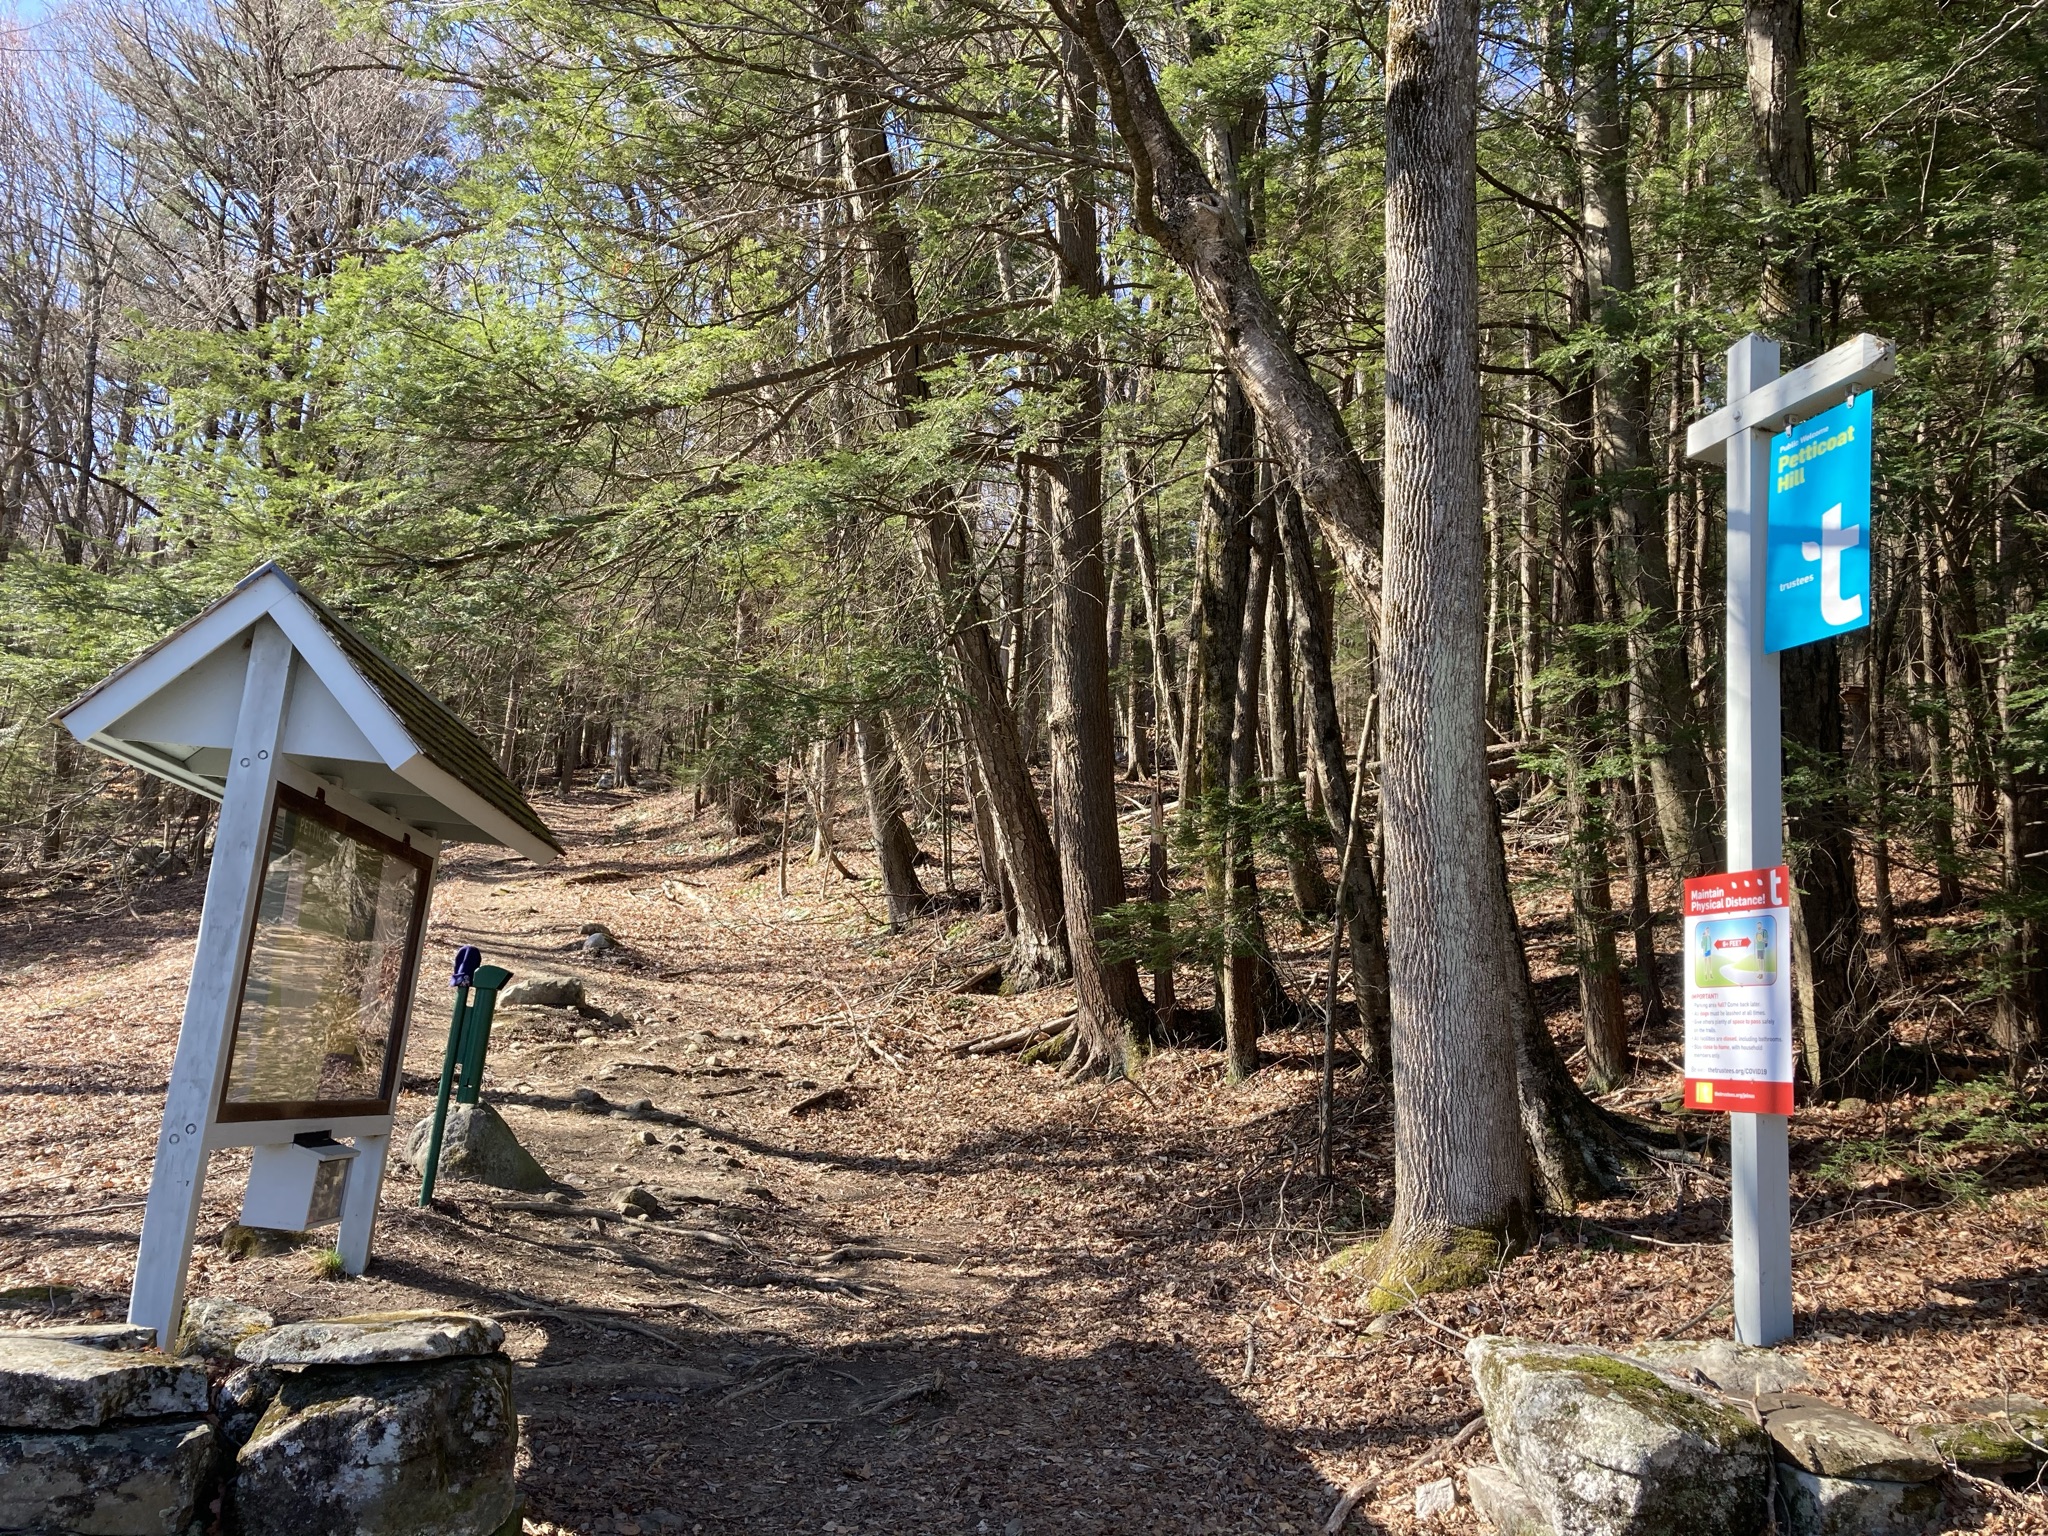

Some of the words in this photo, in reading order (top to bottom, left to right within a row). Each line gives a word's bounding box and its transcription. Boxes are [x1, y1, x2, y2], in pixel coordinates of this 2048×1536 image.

[1778, 425, 1855, 474] Petticoat
[1780, 439, 1799, 454] Public
[1800, 426, 1830, 444] Welcome
[1777, 466, 1805, 494] Hill
[1779, 573, 1815, 592] trustees
[1691, 887, 1725, 901] Maintain
[1691, 900, 1725, 913] Physical
[1725, 893, 1766, 908] Distance!
[1729, 939, 1743, 947] FEET
